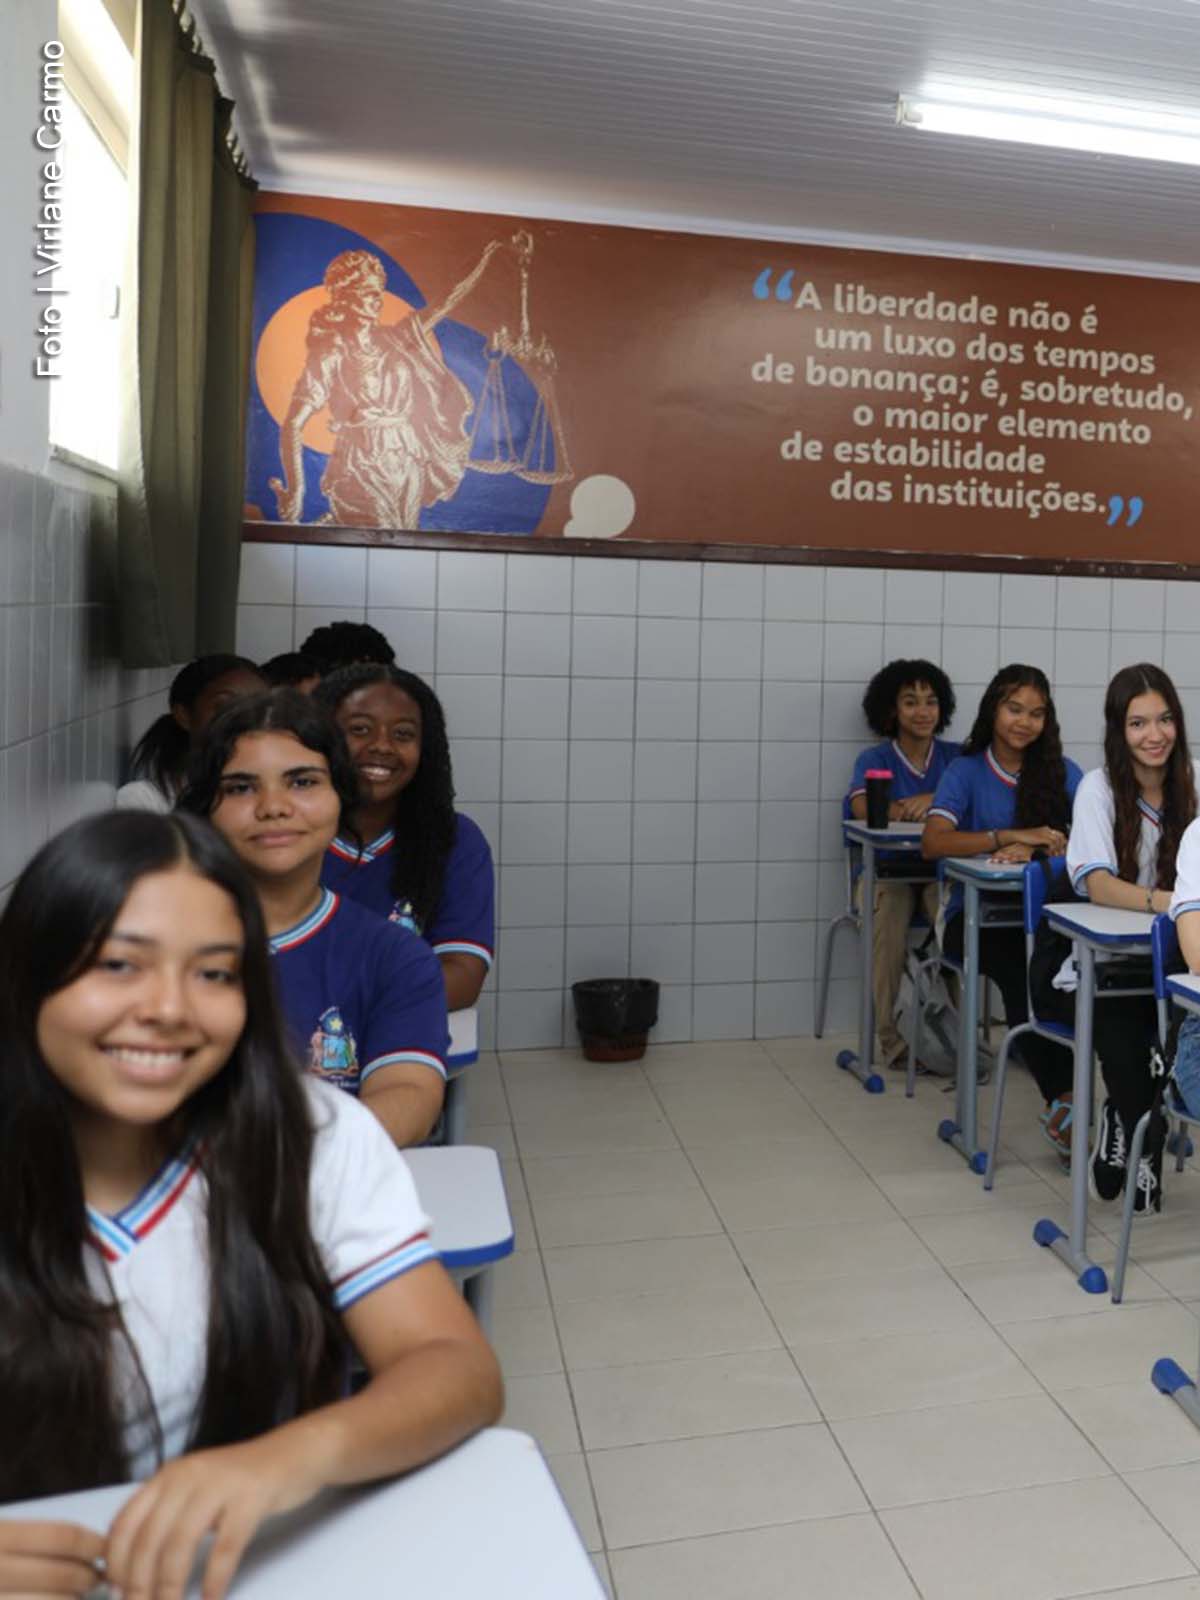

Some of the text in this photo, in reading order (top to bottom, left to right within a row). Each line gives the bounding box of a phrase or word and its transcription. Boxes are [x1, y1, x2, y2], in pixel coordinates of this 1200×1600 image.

[833, 283, 998, 326] liberdade
[1008, 301, 1071, 332] não
[1081, 305, 1098, 334] é
[815, 324, 1156, 377] um luxo dos tempos
[751, 352, 1193, 422] de bonança; é, sobretudo,
[852, 403, 1152, 445] o maior elemento
[780, 430, 1046, 474] de estabilidade
[829, 470, 893, 503] das
